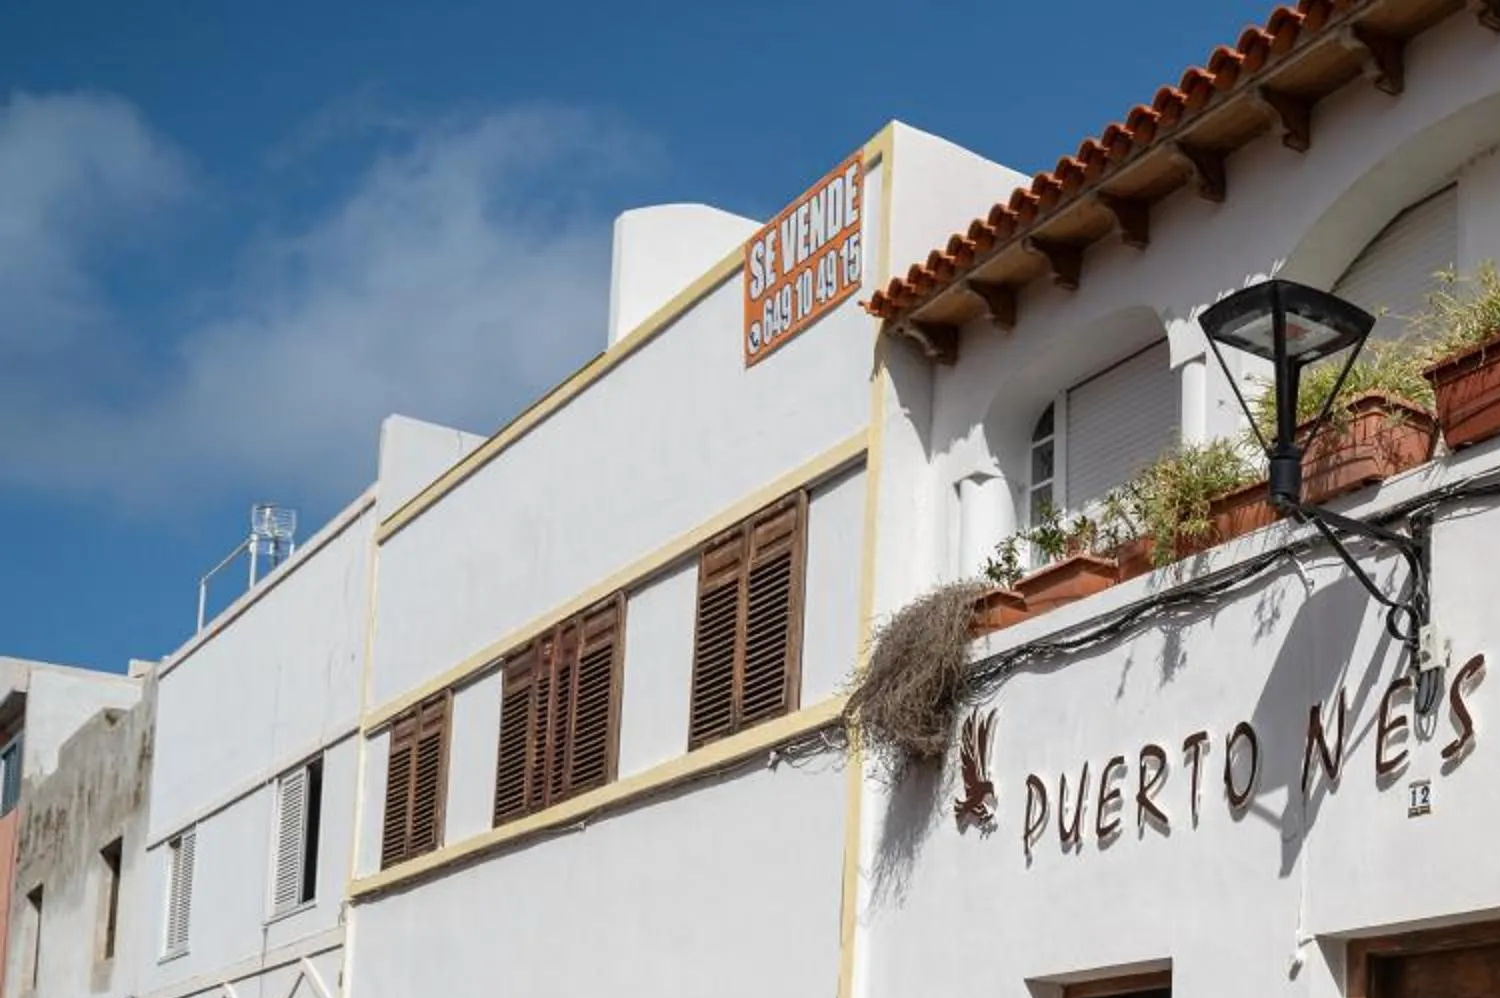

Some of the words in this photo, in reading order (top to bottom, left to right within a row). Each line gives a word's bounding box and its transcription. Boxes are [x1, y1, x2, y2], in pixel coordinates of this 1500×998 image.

[750, 229, 777, 299] SE
[781, 163, 860, 274] VENDE
[763, 283, 792, 345] 649
[795, 267, 813, 320] 10
[816, 250, 838, 304] 49
[840, 232, 861, 287] 15
[1023, 721, 1260, 855] PUERTO
[1411, 785, 1430, 806] 12
